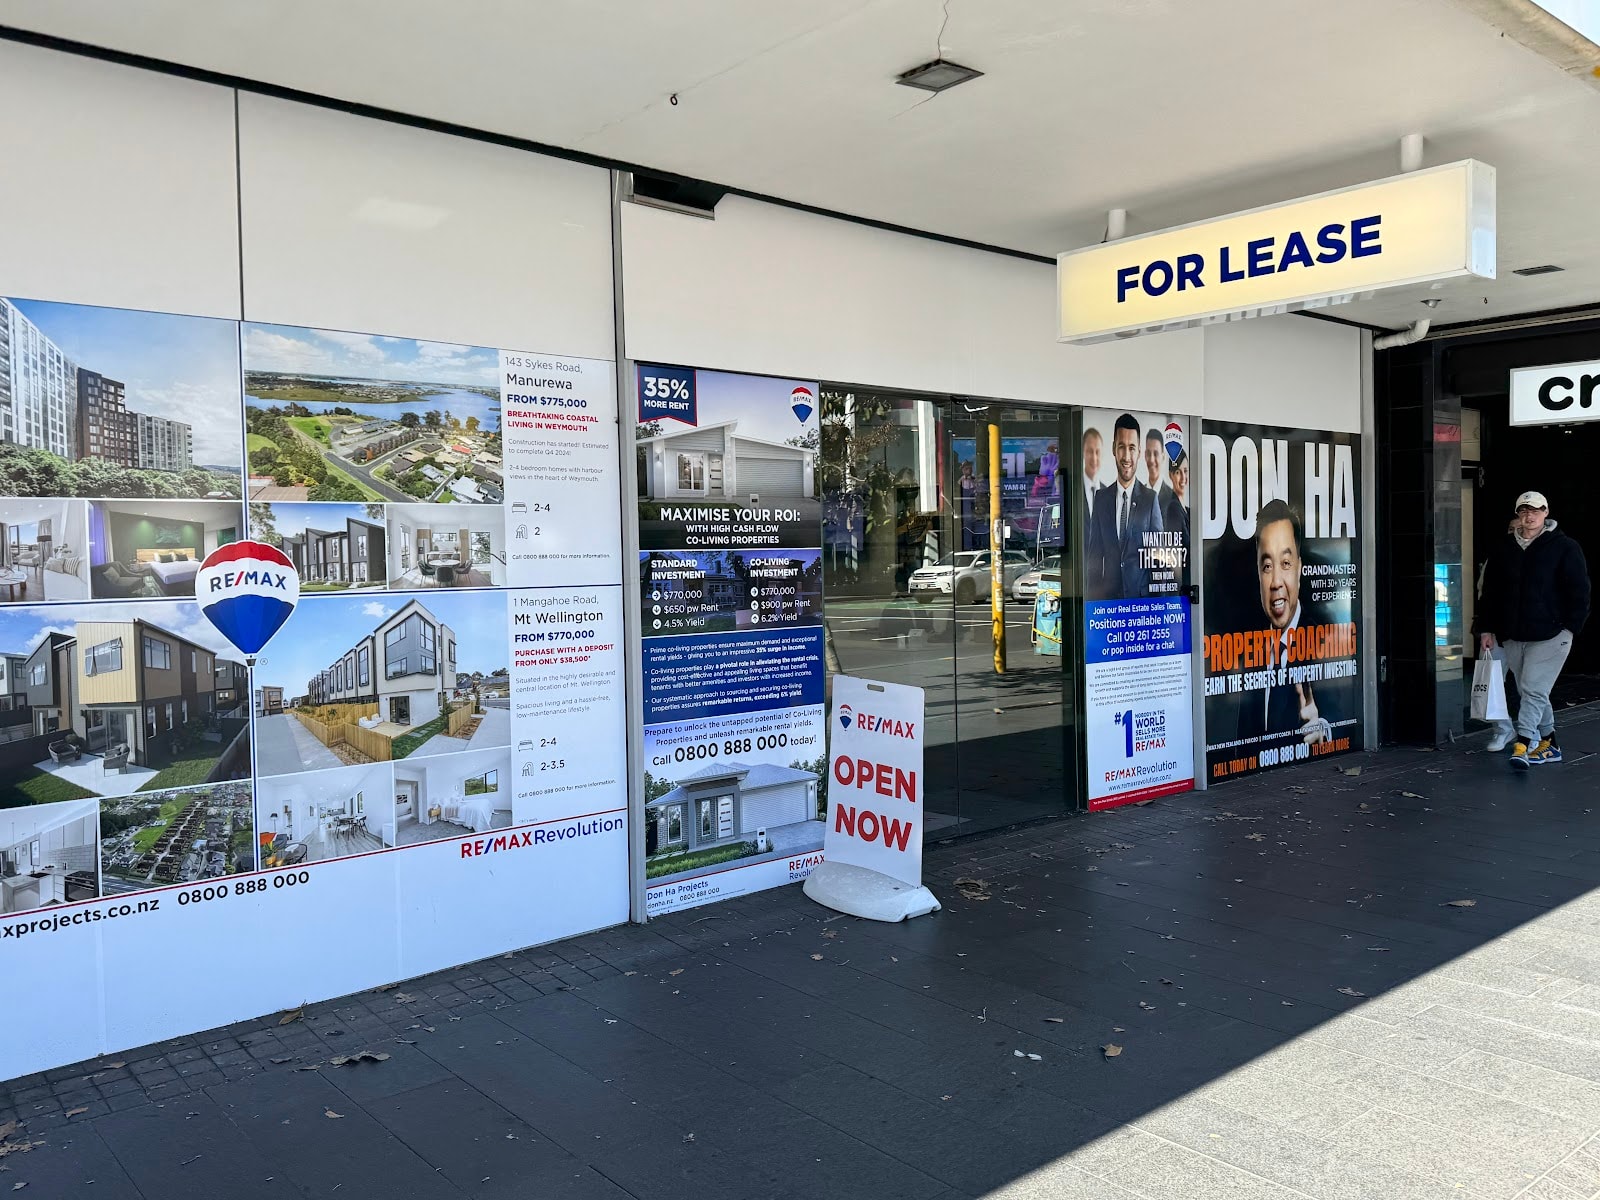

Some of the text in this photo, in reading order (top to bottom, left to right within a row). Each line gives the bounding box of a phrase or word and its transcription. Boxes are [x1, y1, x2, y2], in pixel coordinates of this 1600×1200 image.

[1117, 214, 1382, 303] FOR LEASE
[505, 356, 583, 374] 143 Sykes Road,
[506, 373, 573, 390] Manurewa
[644, 376, 690, 400] 35%
[507, 394, 587, 408] FROM $775,000
[644, 400, 690, 410] MORE RENT
[507, 410, 599, 423] BREATHTAKING COASTAL
[507, 421, 534, 429] LIVING
[544, 423, 588, 432] WEYMOUTH
[1202, 433, 1356, 540] DON HA
[534, 503, 551, 512] 2-4
[660, 508, 801, 522] MAXIMISE YOUR ROI:
[534, 527, 541, 536] 2
[686, 524, 779, 533] WITH HIGH CASH FLOW
[686, 535, 779, 545] CO-LIVING PROPERTIES
[1142, 531, 1183, 547] WANT TO BE
[651, 559, 698, 569] STANDARD
[750, 558, 790, 567] CO-LIVING
[1138, 547, 1187, 569] THE BEST?
[651, 570, 706, 581] INVESTMENT
[750, 568, 798, 578] INVESTMENT
[1302, 563, 1357, 576] GRANDMASTER
[210, 571, 286, 592] RE/MAX
[1310, 577, 1357, 589] WITH 30+ YEARS
[663, 590, 702, 601] $770,000
[760, 586, 795, 596] $770,000
[1312, 590, 1357, 602] OF EXPERIENCE
[514, 594, 599, 608] 1 Mangahoe Road,
[760, 599, 811, 610] $900 pw Rent
[663, 603, 719, 615] $650 pw Rent
[1093, 607, 1105, 615] Join
[1118, 605, 1131, 613] Real
[1132, 604, 1149, 612] Estate
[1151, 603, 1165, 611] Sales
[515, 611, 604, 625] Mt Wellington
[664, 617, 705, 628] 4.5% Yield
[761, 613, 798, 623] 6.2% Yield
[1090, 613, 1185, 630] Positions available NOW!
[515, 629, 595, 643] FROM $770,000
[1106, 628, 1170, 644] Call 09 261 2555
[515, 648, 555, 657] PURCHASE
[556, 646, 576, 654] WITH
[584, 643, 614, 652] DEPOSIT
[1102, 648, 1109, 656] or
[1110, 646, 1124, 656] pop
[1125, 644, 1145, 654] inside
[1145, 642, 1155, 652] for
[1161, 640, 1175, 650] chat
[1203, 621, 1357, 672] PROPERTY COACHING
[515, 659, 537, 667] FROM
[538, 657, 558, 665] ONLY
[1227, 673, 1243, 694] THE
[1243, 669, 1277, 692] SECRETS
[1277, 668, 1288, 686] OF
[1288, 663, 1323, 685] PROPERTY
[1324, 659, 1357, 679] INVESTING
[644, 727, 673, 737] Prepare
[684, 723, 707, 732] unlock
[709, 721, 720, 729] the
[721, 717, 754, 727] untapped
[755, 714, 784, 725] potential
[784, 712, 792, 720] of
[793, 707, 822, 719] Co-Living
[857, 712, 915, 740] RE/MAX
[1135, 715, 1165, 729] WORLD
[656, 719, 814, 747] Properties and unleash remarkable rental yields.
[1114, 709, 1134, 758] #1
[1135, 725, 1166, 737] SELLS MORE
[540, 737, 557, 748] 2-4
[652, 733, 817, 766] Call 0800 888 000 today!
[1135, 737, 1166, 752] RE/MAX
[540, 759, 565, 771] 2-3.5
[1214, 742, 1310, 778] CALL TODAY ON 0800 888 000
[834, 754, 916, 803] OPEN
[835, 803, 913, 852] NOW
[789, 854, 825, 871] RE/MAX
[647, 880, 709, 901] Don Ha Projects
[679, 893, 695, 902] 0800
[707, 887, 720, 895] 000
[0, 871, 310, 939] xprojects.co.nz 0800 888 000
